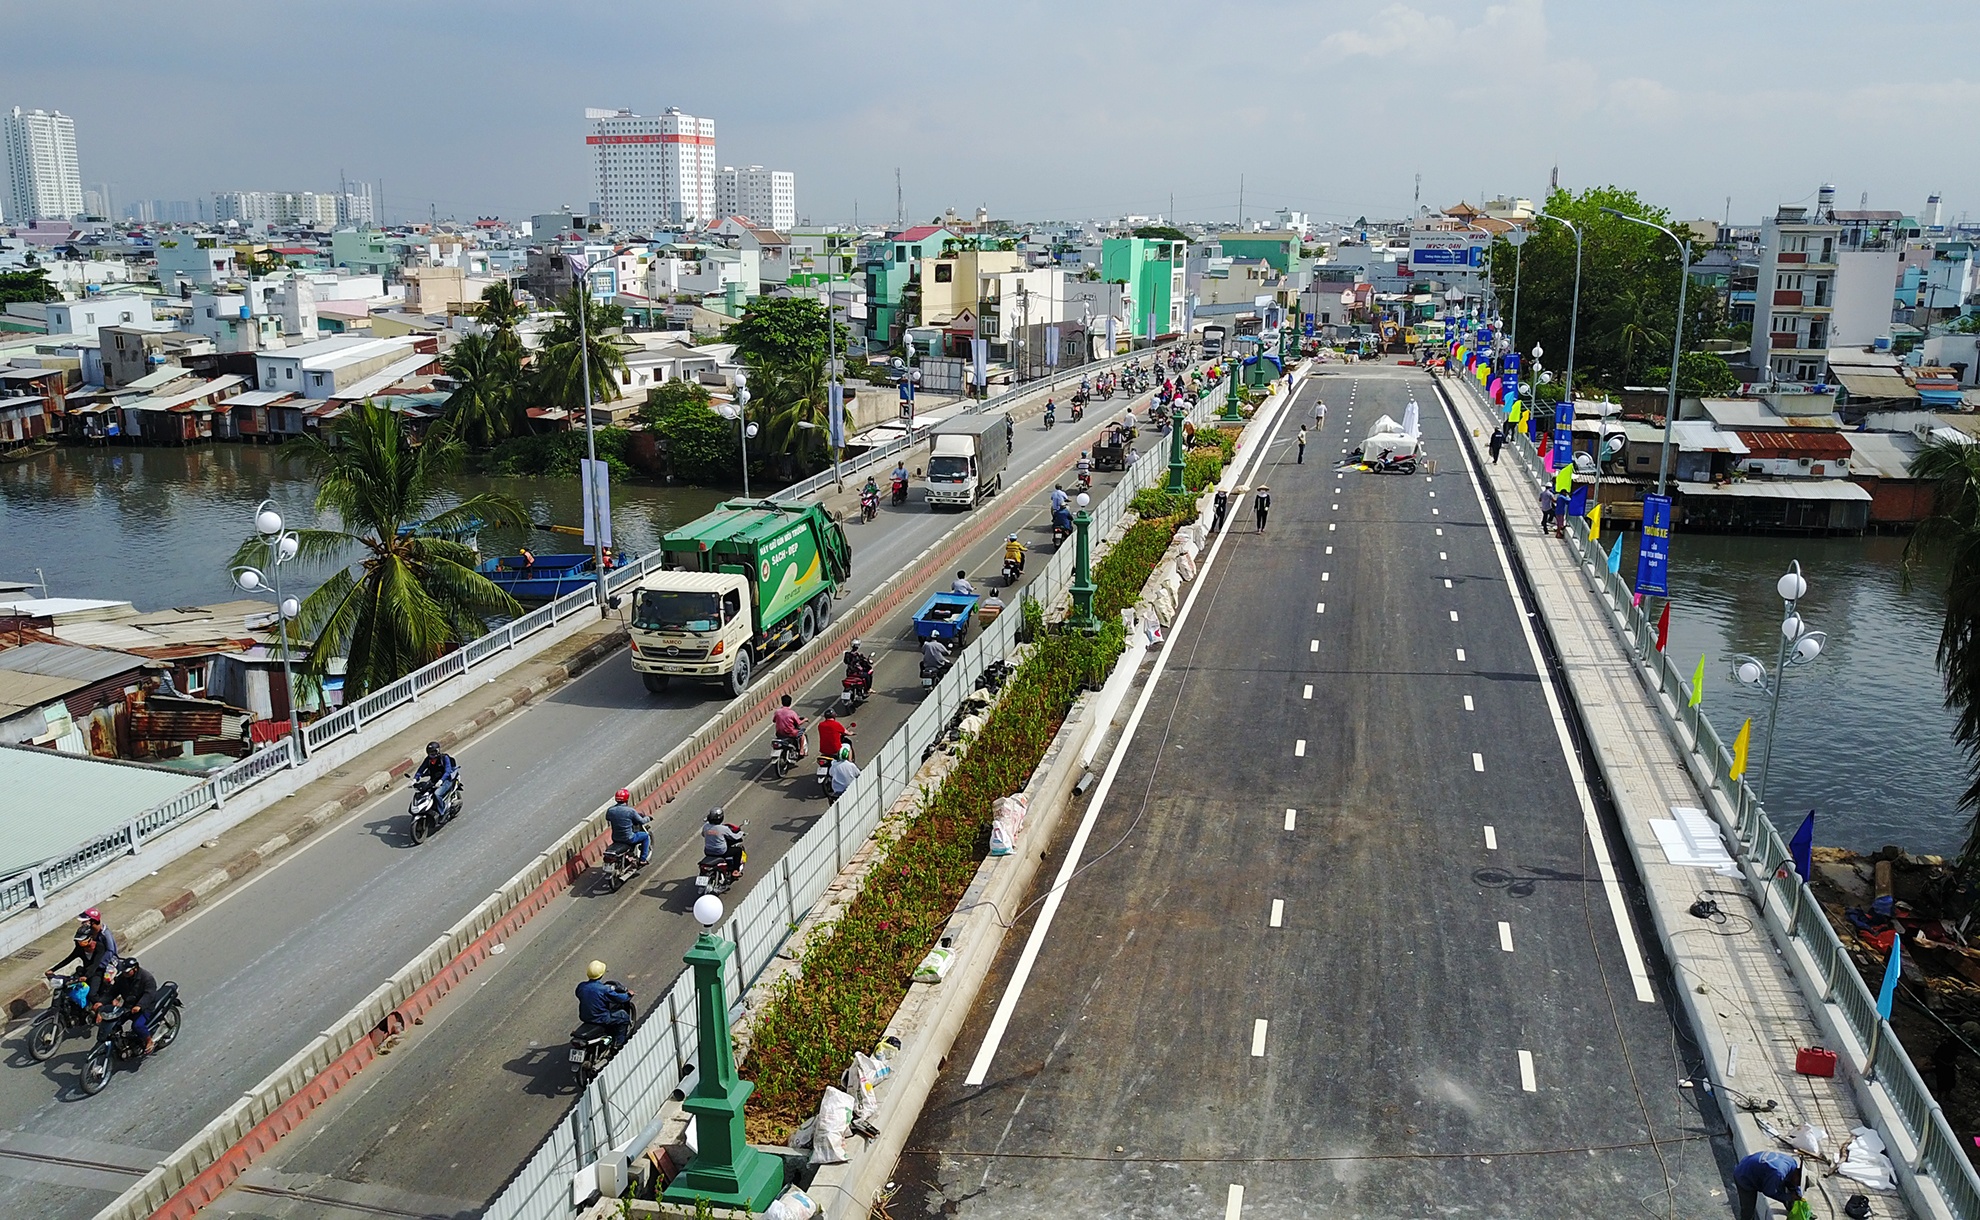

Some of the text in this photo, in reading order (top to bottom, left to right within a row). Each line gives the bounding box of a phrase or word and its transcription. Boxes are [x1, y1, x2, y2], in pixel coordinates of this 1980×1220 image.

[1660, 529, 1668, 538] XE
[772, 550, 786, 566] SẠCH
[788, 542, 798, 556] ĐẸP
